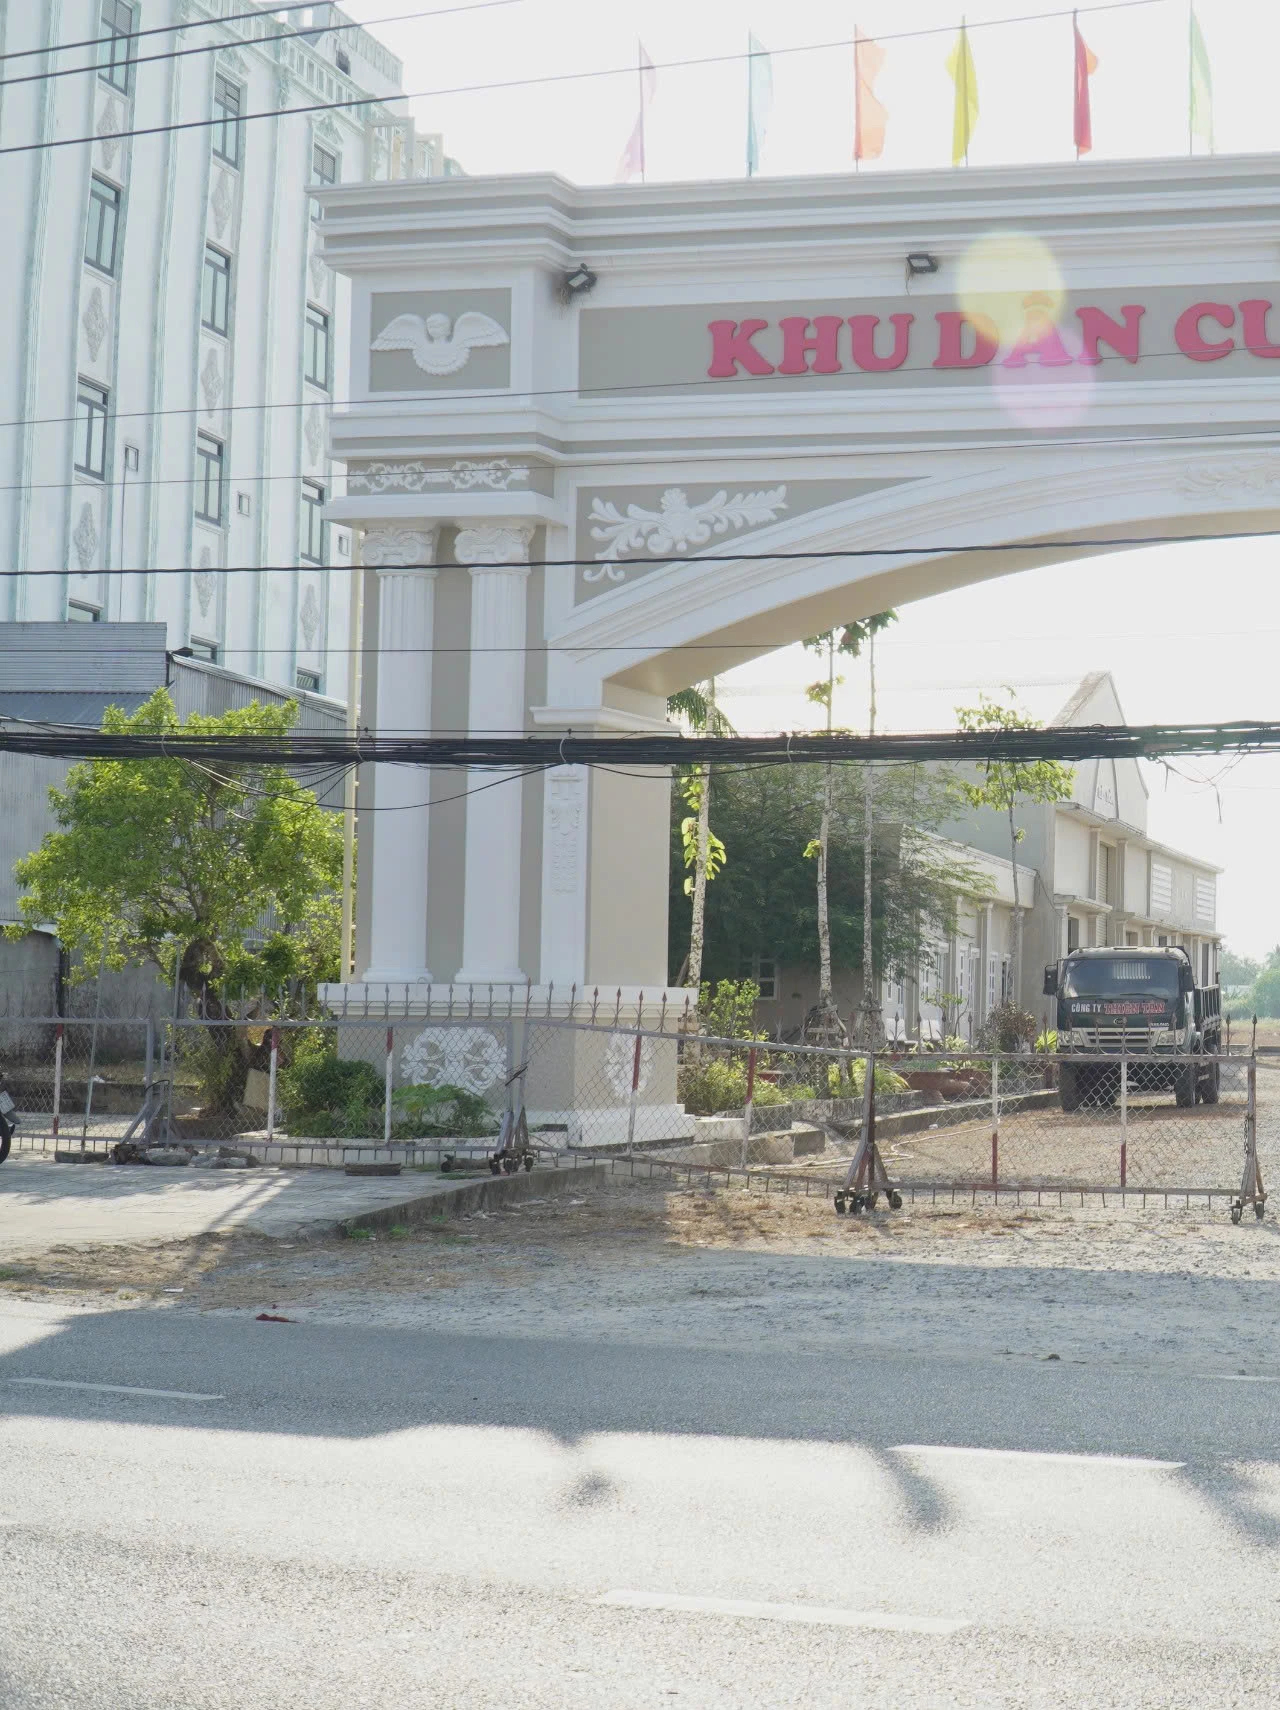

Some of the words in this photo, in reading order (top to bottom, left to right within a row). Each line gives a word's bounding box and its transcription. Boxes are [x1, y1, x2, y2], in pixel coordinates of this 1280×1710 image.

[707, 313, 915, 378] KHU
[933, 291, 1146, 369] DÂN
[1071, 1002, 1091, 1013] CÔNG
[1093, 1003, 1102, 1013] TY
